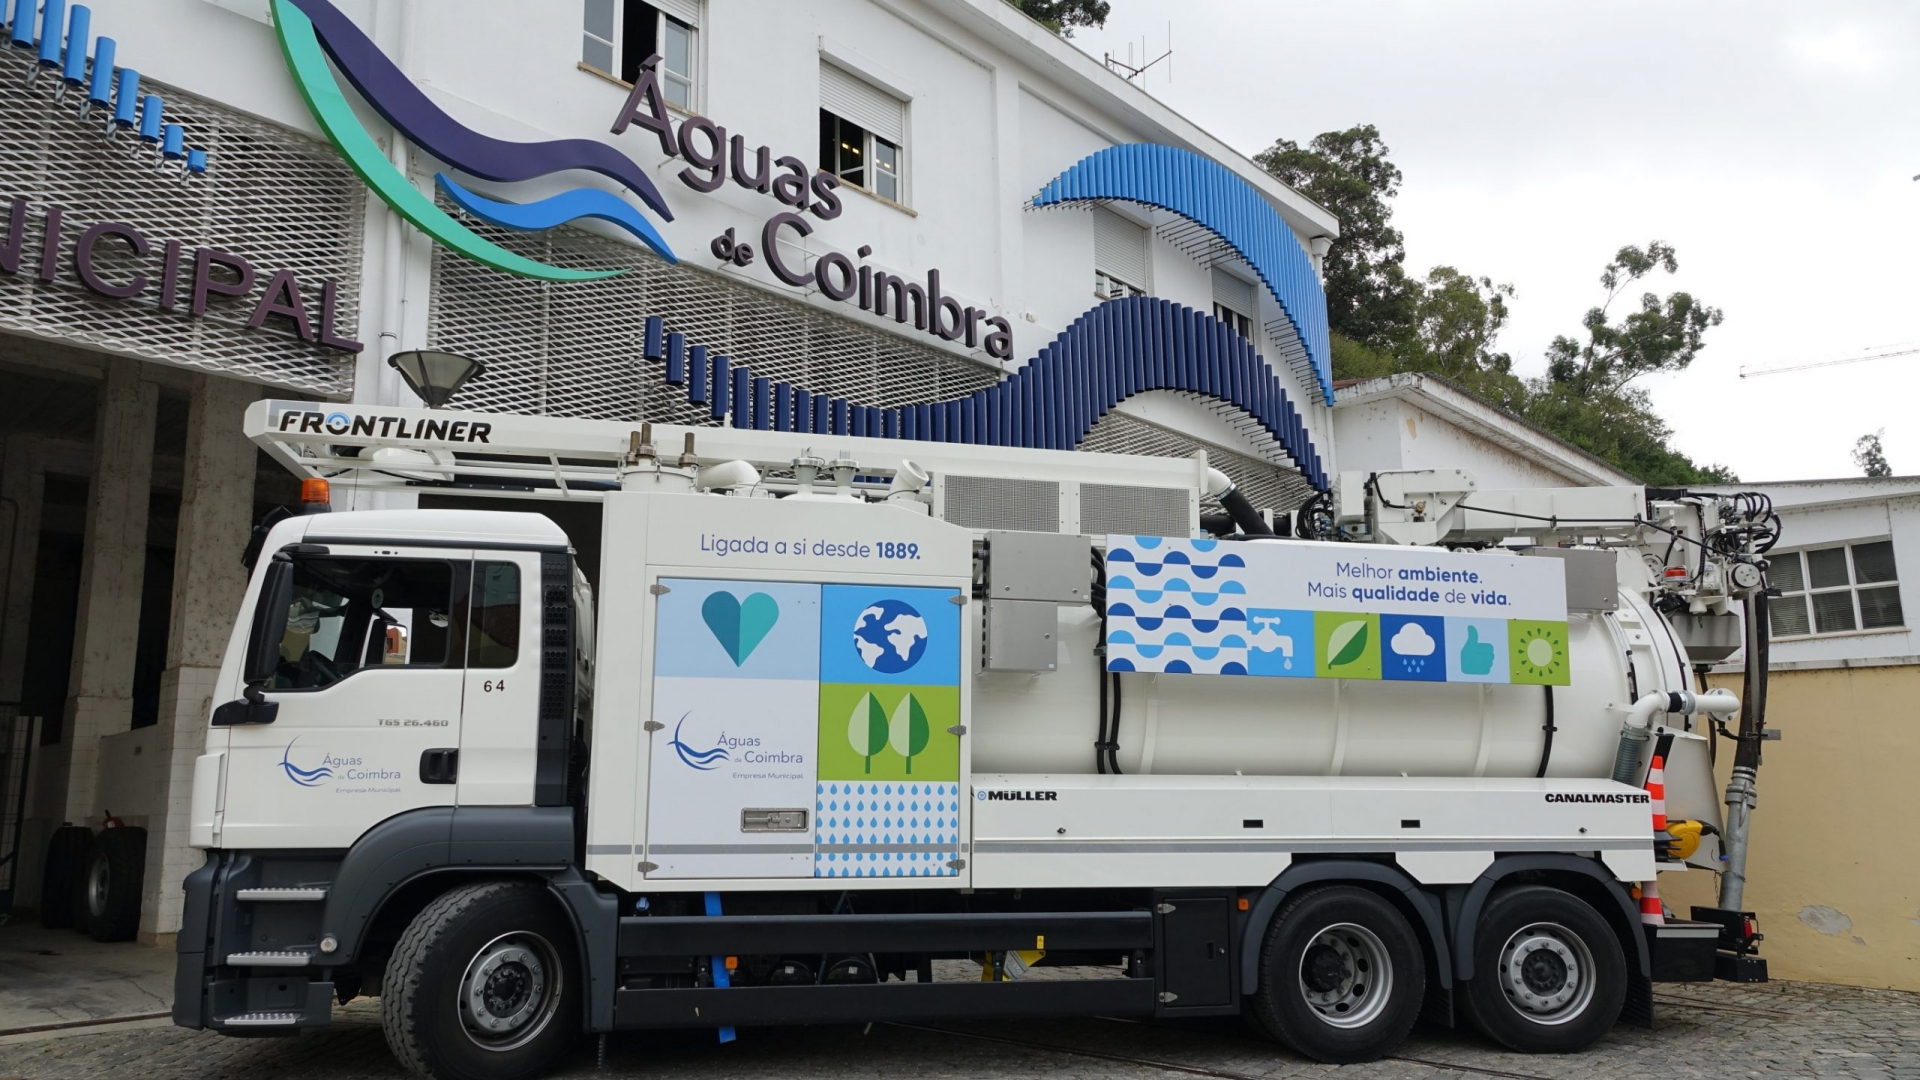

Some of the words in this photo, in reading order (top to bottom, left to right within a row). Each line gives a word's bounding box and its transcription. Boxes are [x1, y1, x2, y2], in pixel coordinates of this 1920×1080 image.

[610, 53, 843, 221] Águas
[711, 227, 754, 267] de
[762, 212, 1014, 361] Coimbra
[279, 410, 492, 444] FRONTLINER
[701, 533, 769, 557] Ligada
[774, 541, 787, 555] a
[793, 538, 806, 556] si
[812, 539, 871, 558] desde
[875, 541, 921, 560] 1889.
[1336, 561, 1394, 580] Melhor
[1398, 566, 1483, 584] ambiente.
[1308, 581, 1347, 598] Mais
[1352, 585, 1440, 603] qualidade
[1444, 588, 1466, 604] de
[1470, 589, 1512, 606] vida.
[378, 718, 401, 726] TGS
[403, 719, 449, 727] 26.460
[717, 731, 761, 750] Águas
[322, 752, 363, 768] Águas
[744, 750, 803, 764] Coimbra
[347, 768, 401, 780] Coimbra
[732, 772, 767, 780] Empresa
[767, 772, 804, 780] Municipal
[988, 790, 1058, 801] MÜLLER
[1544, 793, 1650, 803] CANALMASTER
